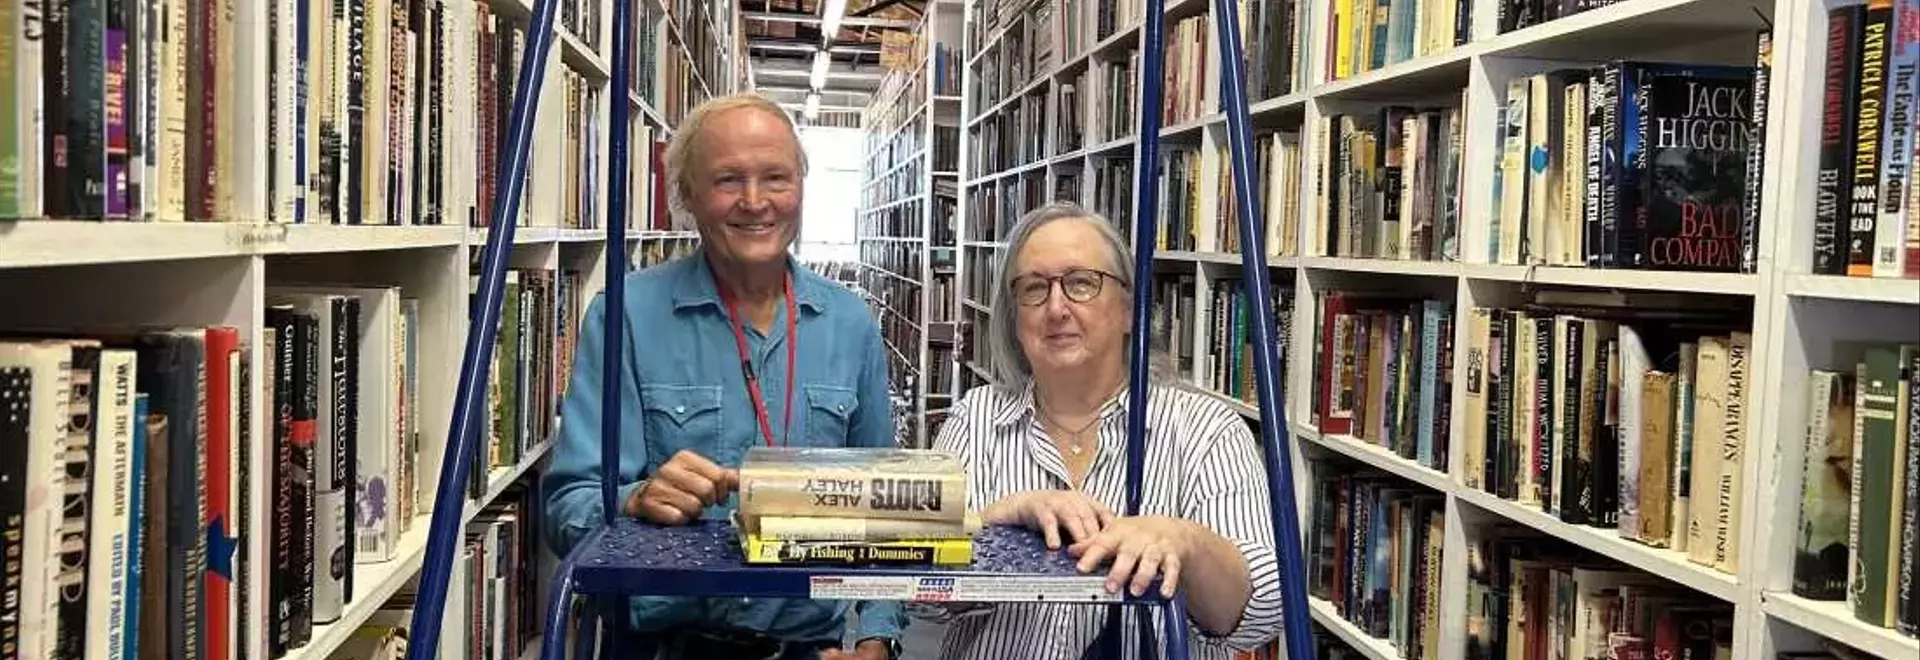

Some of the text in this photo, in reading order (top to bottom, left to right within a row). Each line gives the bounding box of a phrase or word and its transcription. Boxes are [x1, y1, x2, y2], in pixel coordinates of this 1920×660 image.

[1896, 62, 1915, 92] The
[1681, 81, 1746, 119] JACK
[1855, 22, 1886, 181] PATRICIA CORNWELL
[1890, 92, 1911, 137] Eagle
[1634, 83, 1652, 169] JACK HIGGINS
[1656, 117, 1752, 150] HIGGIN
[1587, 126, 1600, 222] ANGEL OF DEATH
[1852, 185, 1877, 200] OOK
[1884, 163, 1906, 214] Flown
[1679, 200, 1741, 238] BAD
[1850, 217, 1873, 232] EAD
[1650, 236, 1745, 267] COMPAN
[282, 324, 296, 382] Guinier
[116, 362, 129, 406] WATTS
[1725, 344, 1747, 462] DISAPPEARANCES
[114, 414, 126, 438] THE
[112, 440, 127, 517] AFTERMATH
[802, 478, 863, 492] HALEY
[870, 478, 942, 512] ROOTS
[814, 494, 861, 506] ALEX
[111, 533, 123, 579] EDITED
[811, 546, 854, 561] Fishing
[868, 546, 924, 560] Dummies
[1900, 508, 1916, 601] THOMPSON
